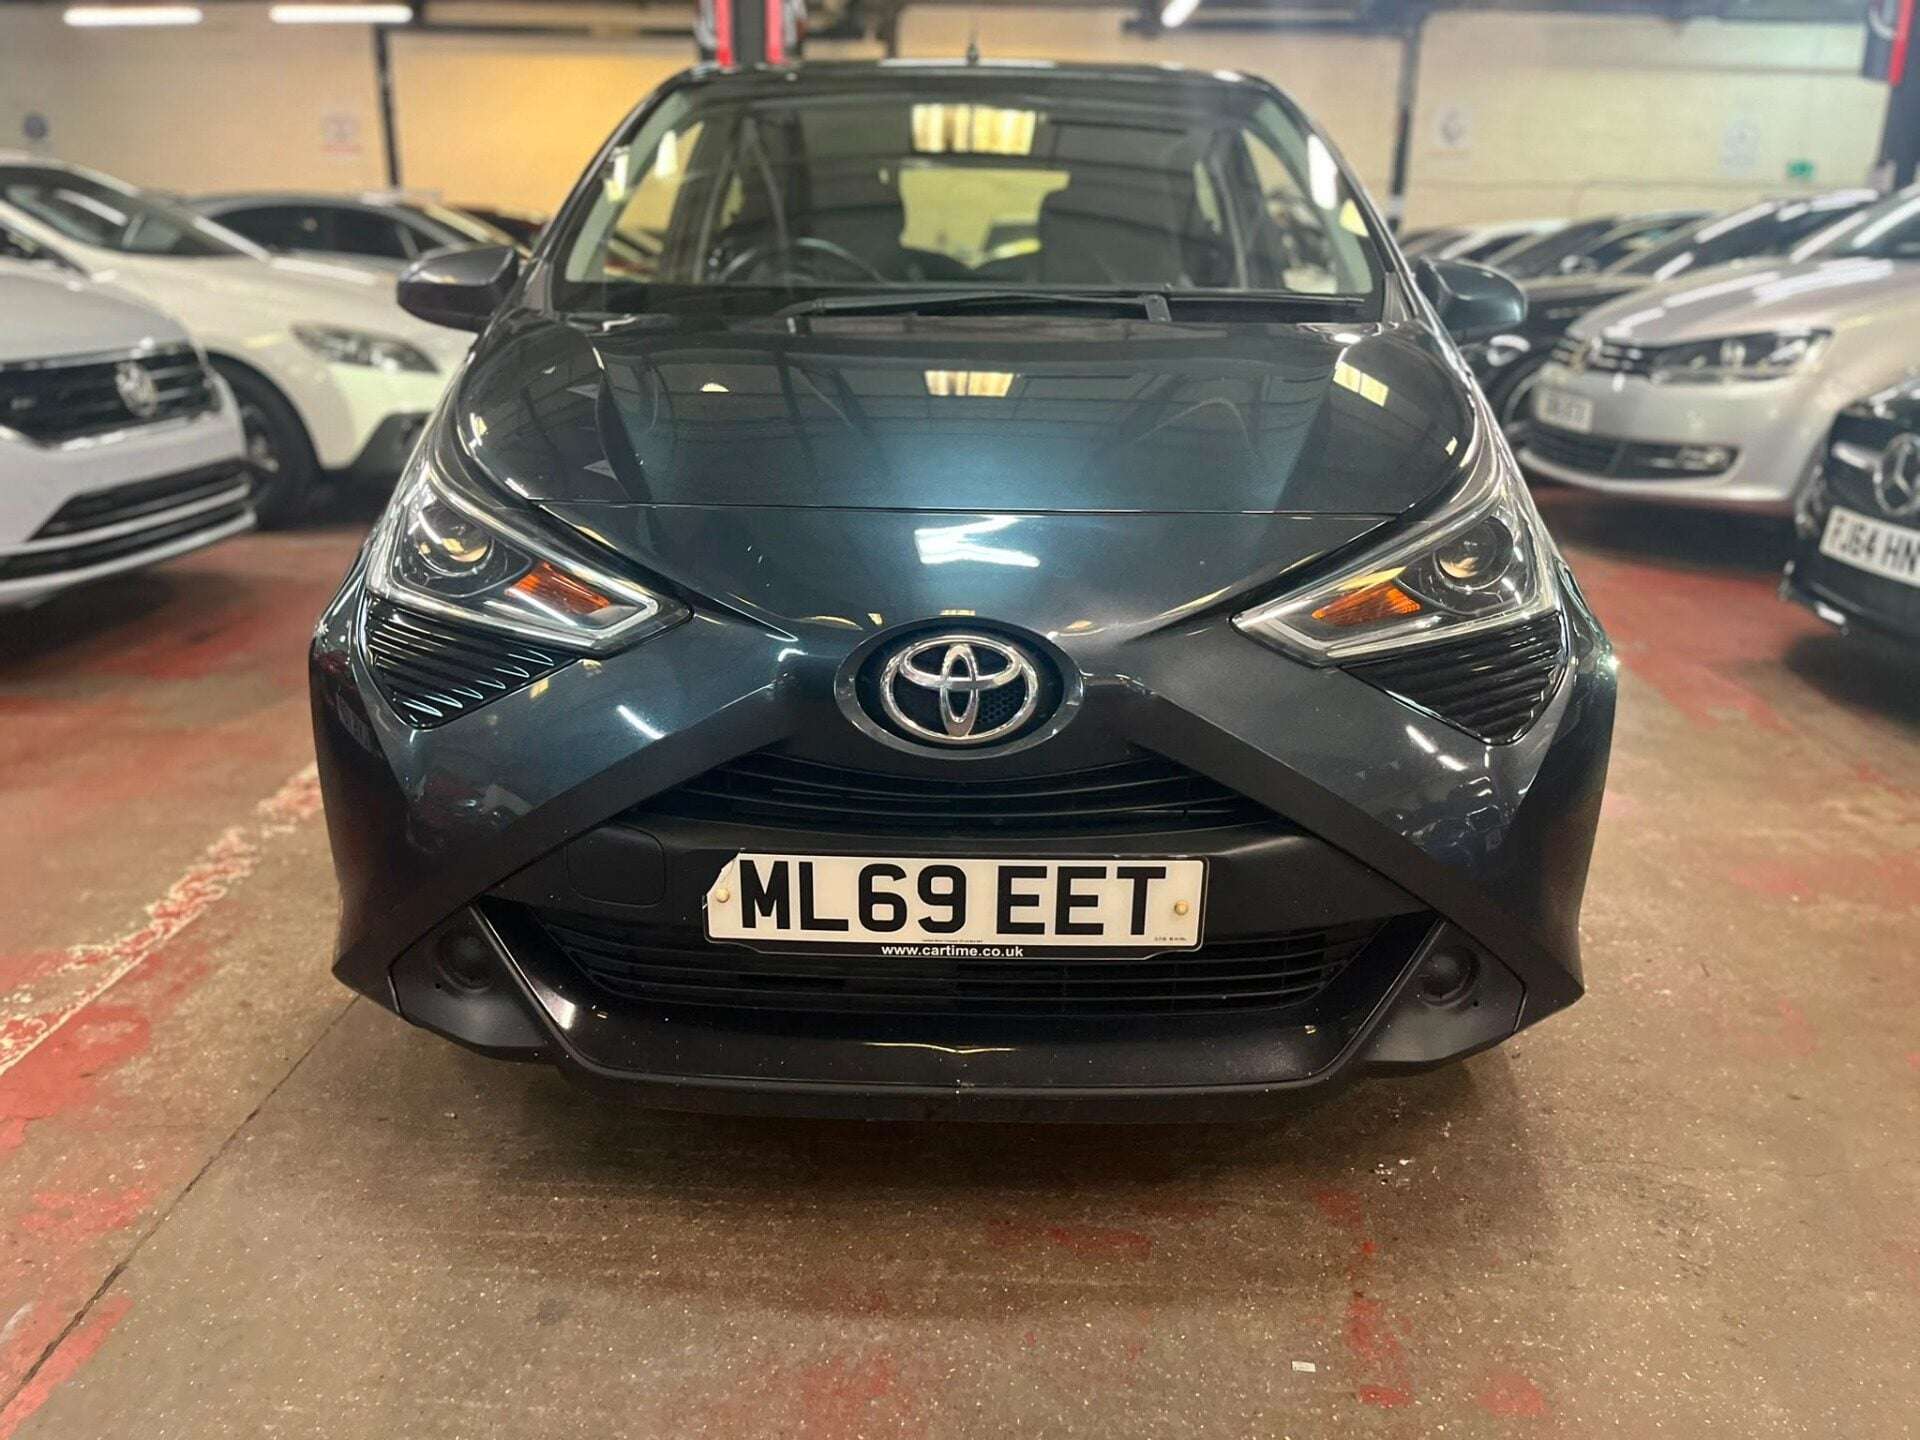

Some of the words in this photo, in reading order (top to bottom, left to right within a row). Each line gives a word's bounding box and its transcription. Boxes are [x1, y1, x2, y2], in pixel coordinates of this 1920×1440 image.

[740, 860, 967, 934] ML69
[996, 865, 1167, 936] EET
[881, 944, 1024, 957] www.cartime.co.uk
